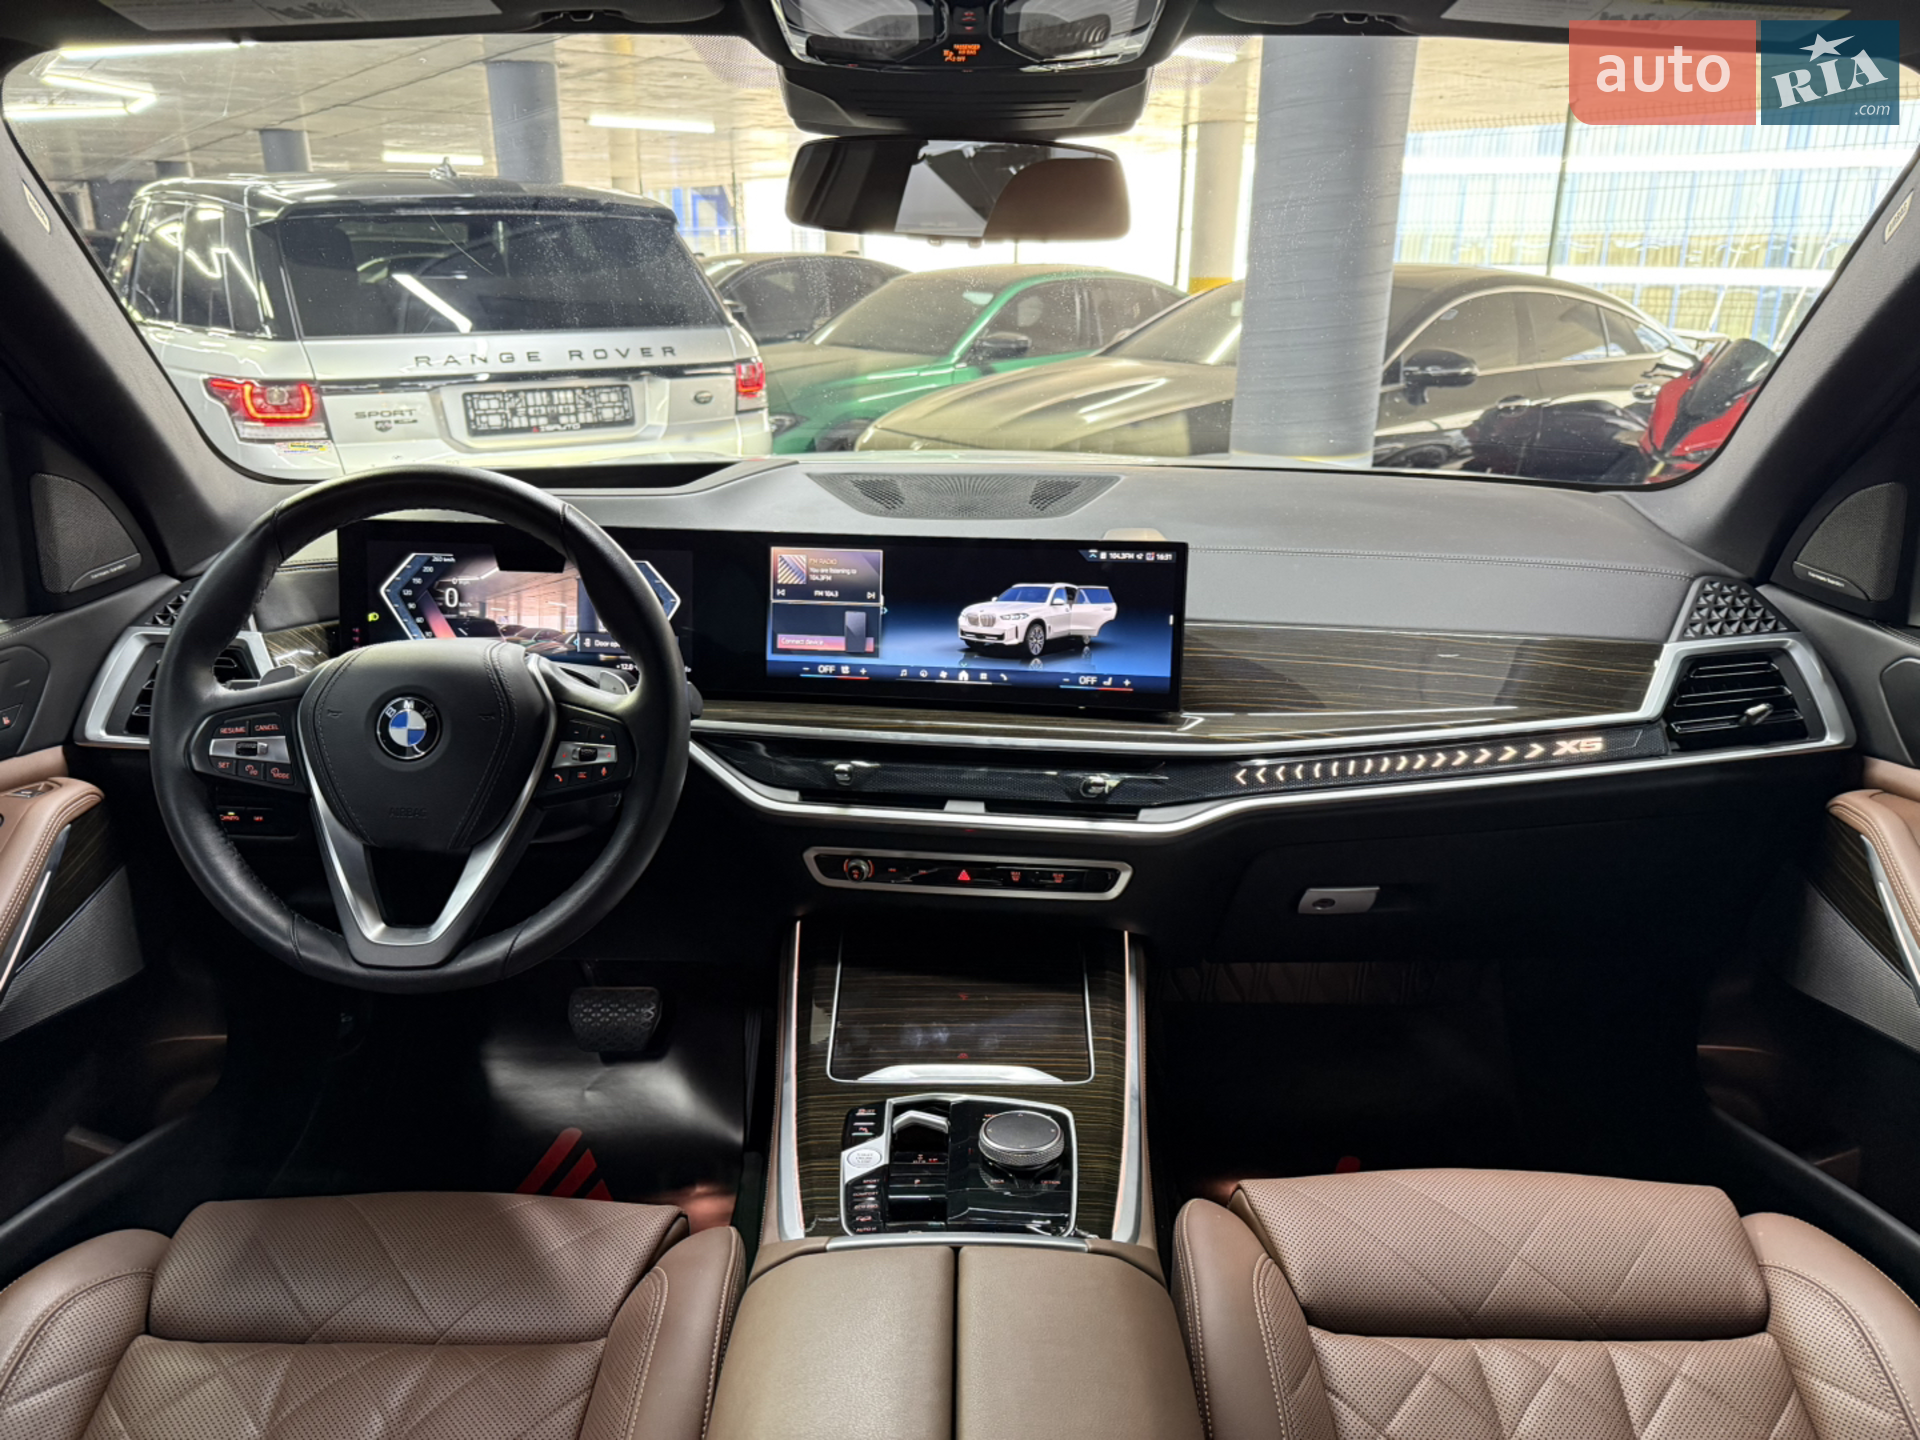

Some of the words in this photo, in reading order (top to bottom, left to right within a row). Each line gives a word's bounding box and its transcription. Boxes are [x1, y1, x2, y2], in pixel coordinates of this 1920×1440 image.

[414, 351, 542, 367] RANGE
[568, 346, 677, 361] ROVER
[354, 409, 417, 419] SPORT
[444, 587, 459, 608] 0
[818, 665, 836, 674] OFF
[1078, 675, 1098, 685] OFF
[384, 699, 434, 720] BMW
[219, 726, 247, 735] RESUME
[254, 723, 280, 732] CANCEL
[1551, 737, 1603, 757] X5
